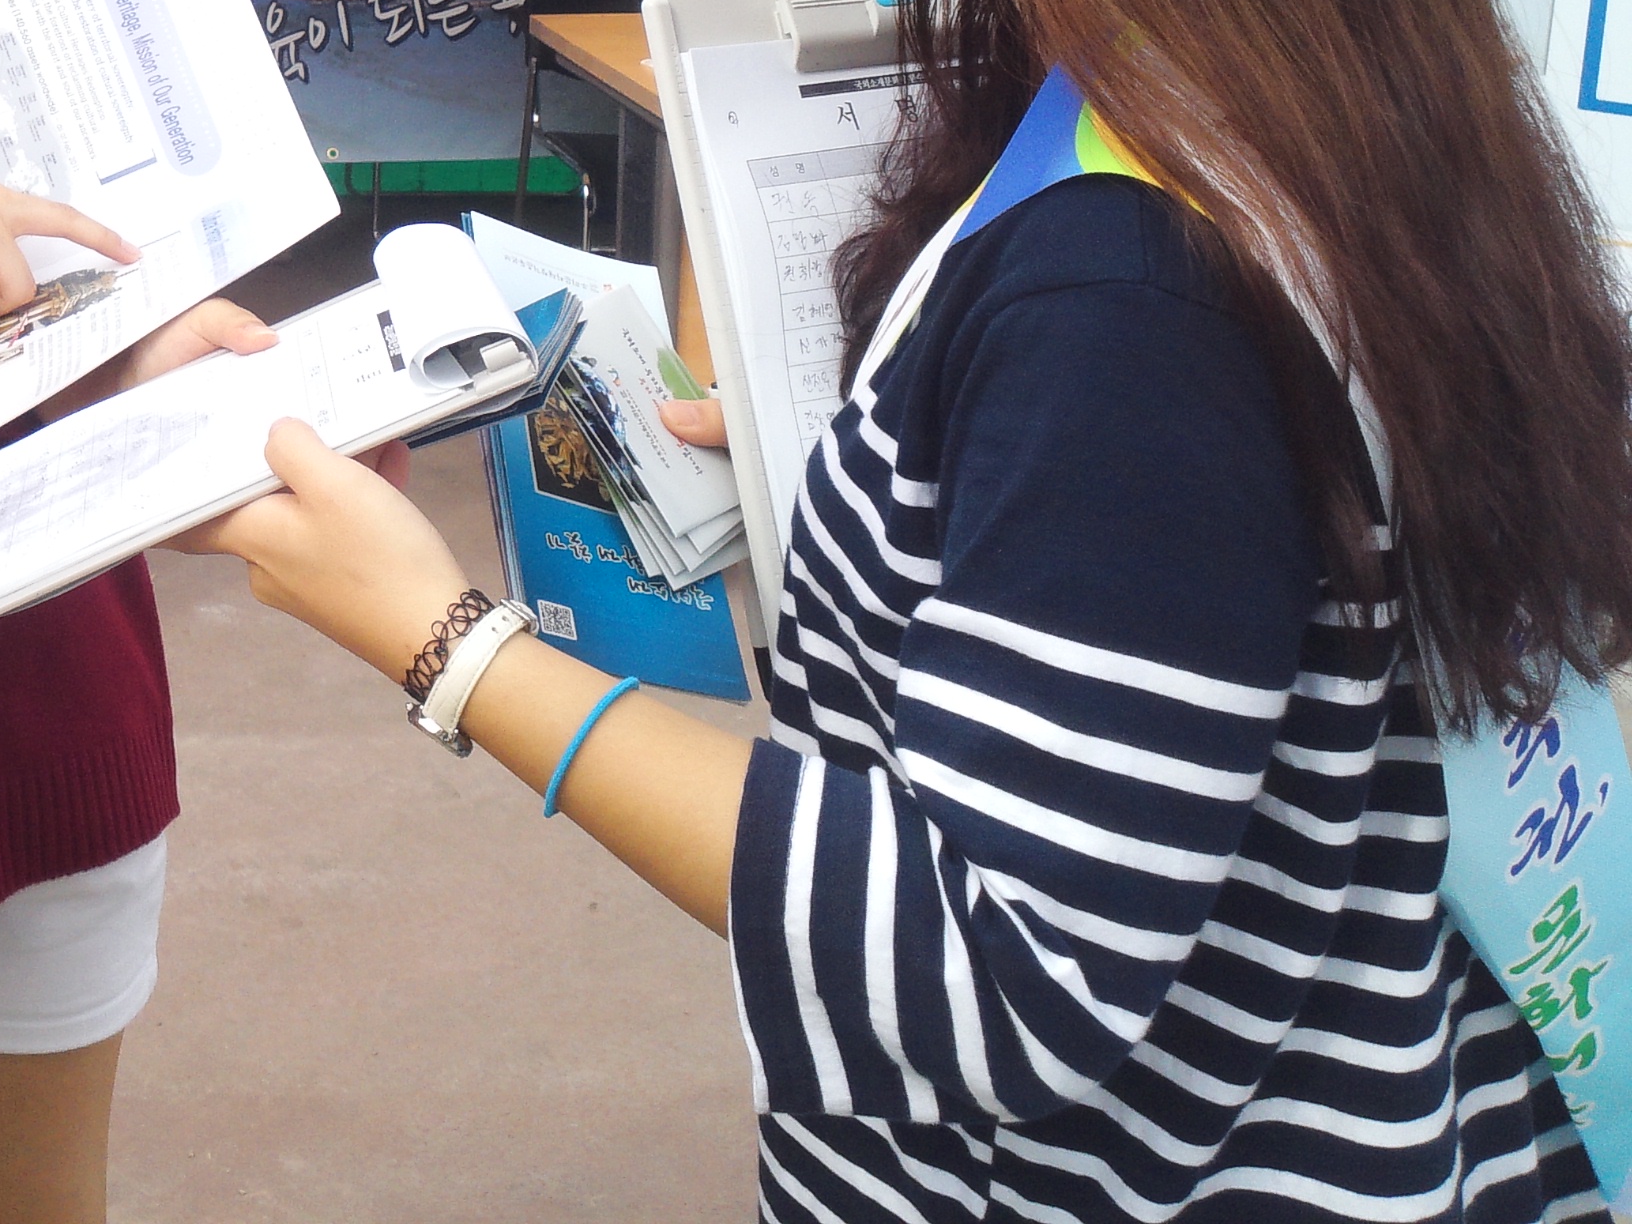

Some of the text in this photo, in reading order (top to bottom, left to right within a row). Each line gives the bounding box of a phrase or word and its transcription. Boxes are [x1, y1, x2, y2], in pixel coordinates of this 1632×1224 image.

[130, 32, 164, 75] Mission
[146, 71, 168, 87] of
[150, 83, 176, 108] Our
[158, 103, 200, 166] Generation
